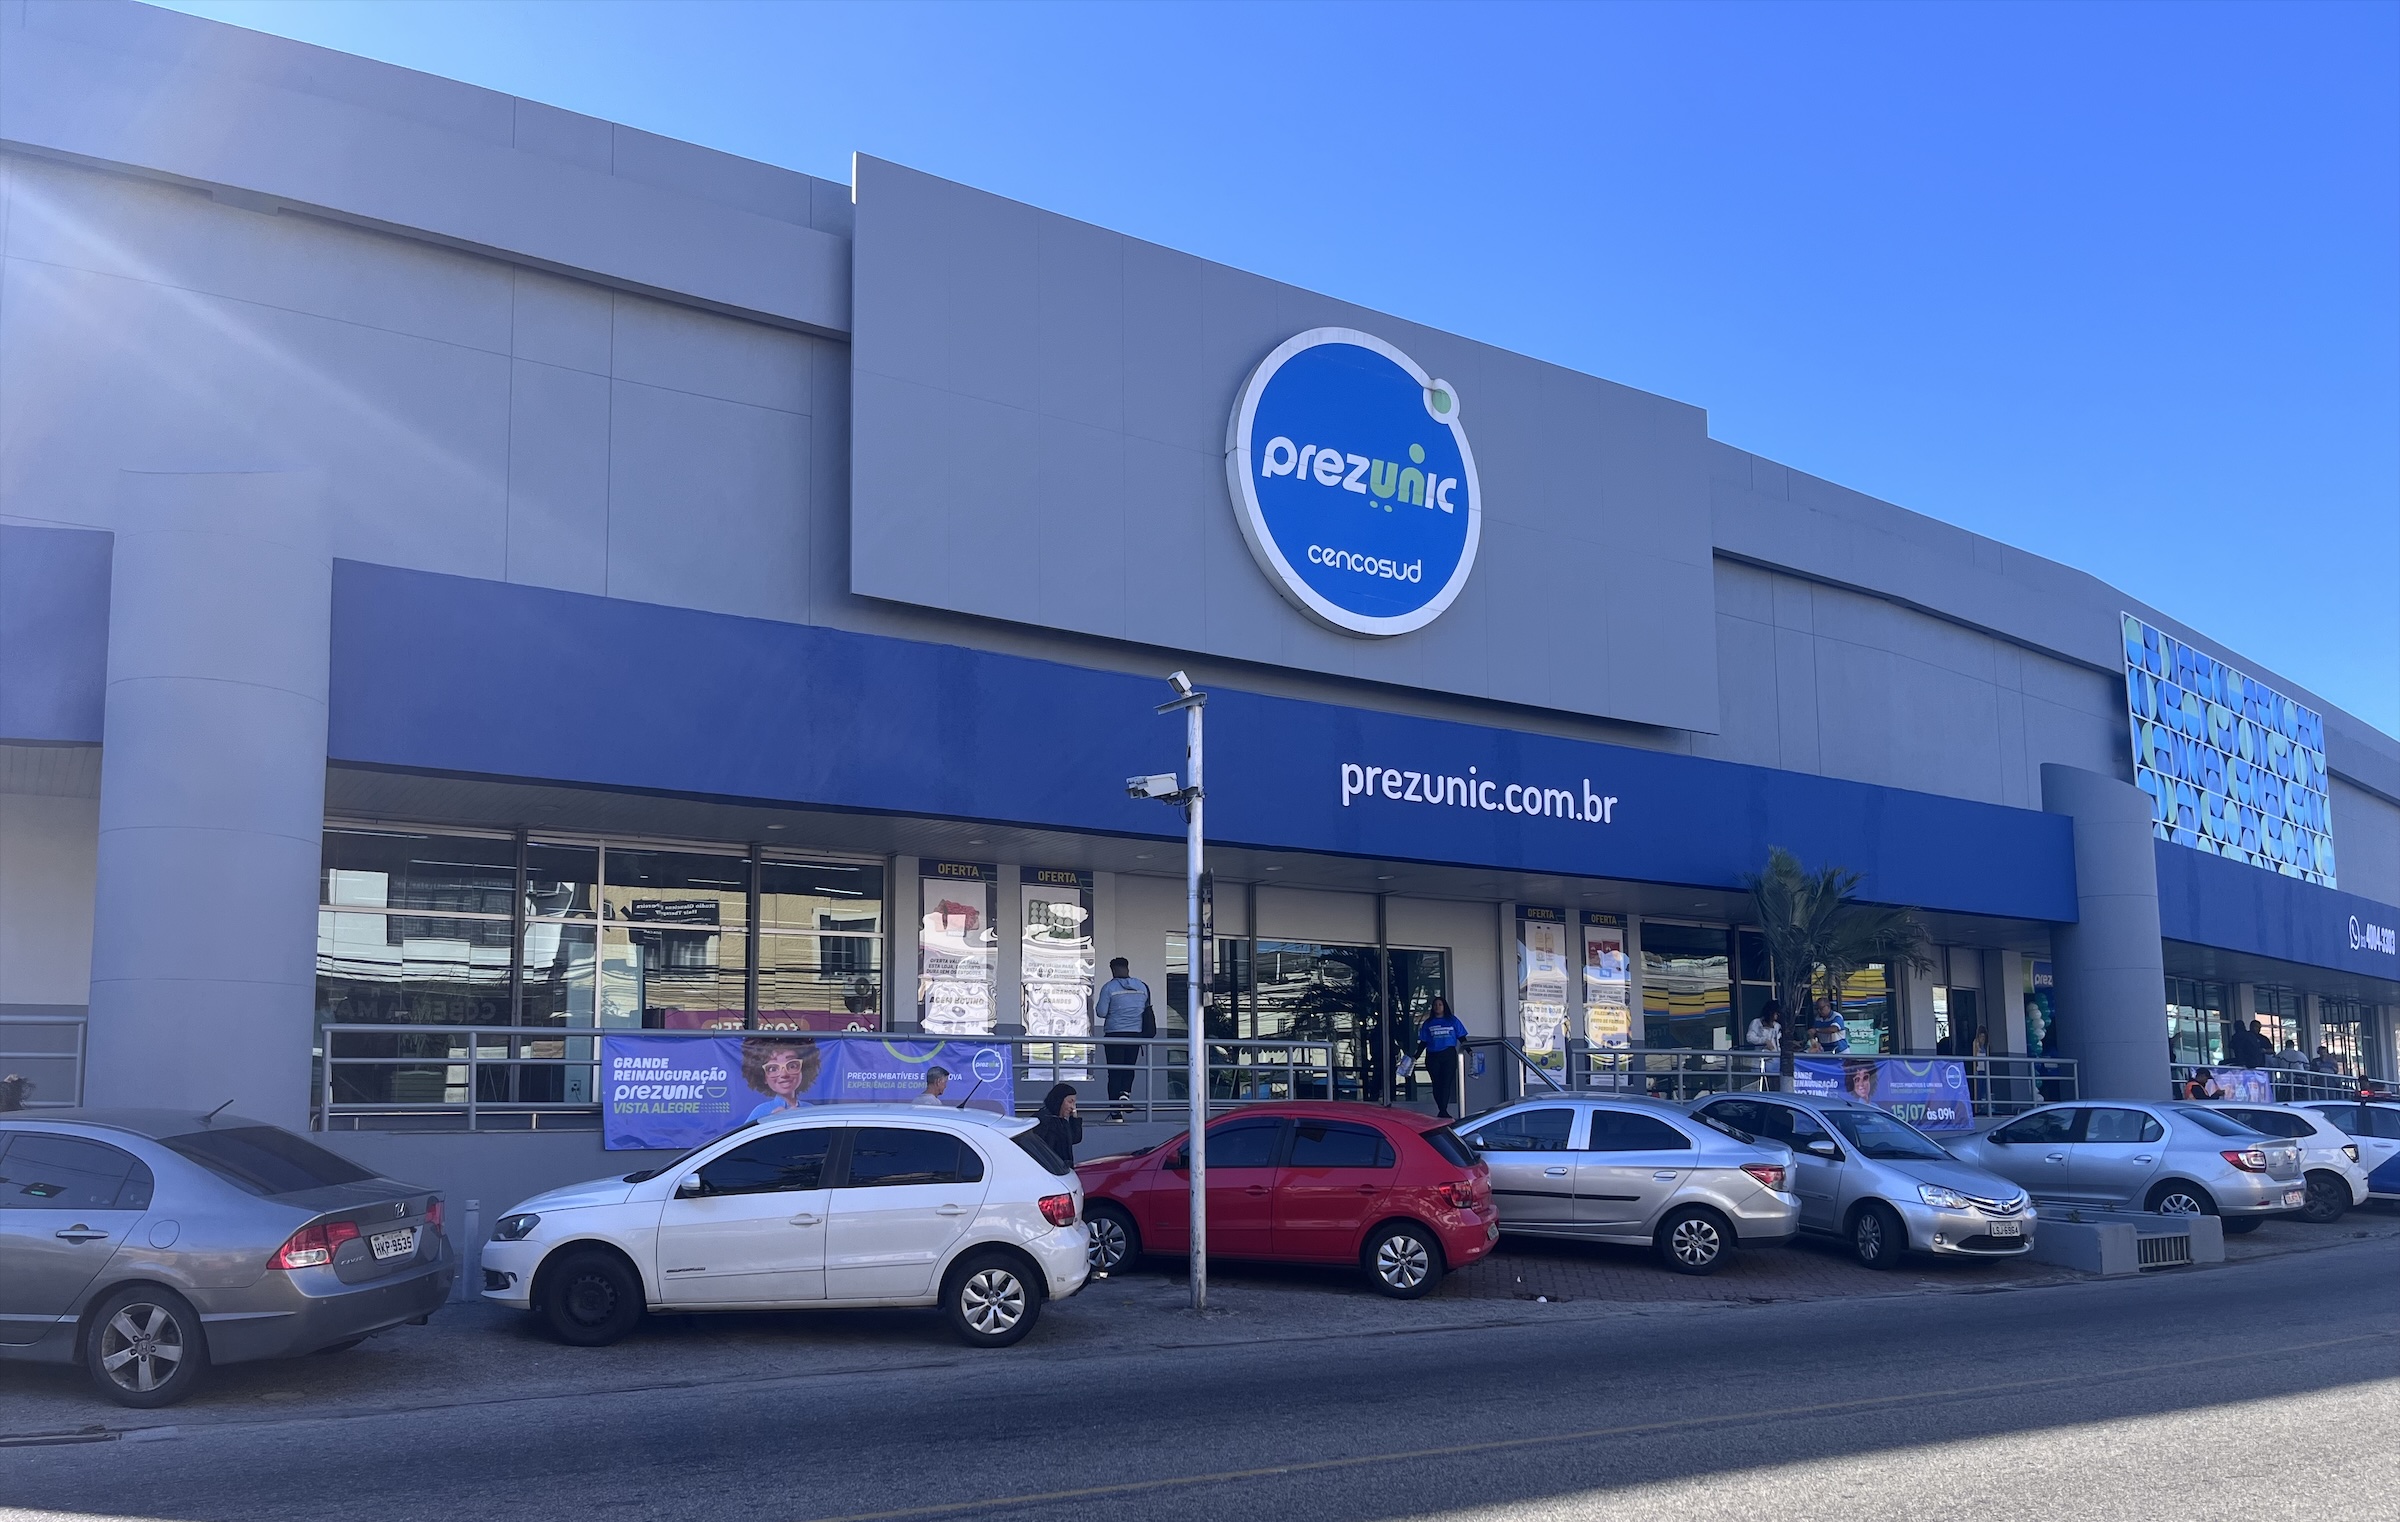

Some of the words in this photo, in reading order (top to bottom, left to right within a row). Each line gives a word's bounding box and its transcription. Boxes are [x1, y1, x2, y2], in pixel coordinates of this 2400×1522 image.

[1261, 435, 1458, 514] prezunic
[1307, 543, 1423, 584] cencosud
[1340, 761, 1619, 825] prezunic.com.br
[937, 863, 980, 877] OFERTA
[1037, 870, 1077, 884] OFERTA
[1527, 908, 1555, 919] OFERTA
[1590, 913, 1617, 925] OFERTA
[2034, 973, 2053, 986] prez
[613, 1057, 670, 1069] GRANDE
[613, 1066, 728, 1085] REINAUGURAÇÃO
[847, 1071, 877, 1081] PREÇOS
[877, 1070, 920, 1081] IMBATÍVEIS
[919, 1072, 926, 1080] E
[948, 1072, 963, 1081] OVA
[1793, 1071, 1814, 1080] RANDE
[847, 1079, 897, 1089] EXPERIÊNCIA
[897, 1081, 907, 1089] DE
[1793, 1078, 1839, 1091] EINAUGURAÇÃO
[613, 1084, 705, 1102] prezunic
[613, 1102, 650, 1114] VISTA
[651, 1102, 701, 1114] ALEGRE
[1890, 1103, 1926, 1121] 15/07
[1926, 1107, 1938, 1121] às
[1937, 1107, 1956, 1121] 09h
